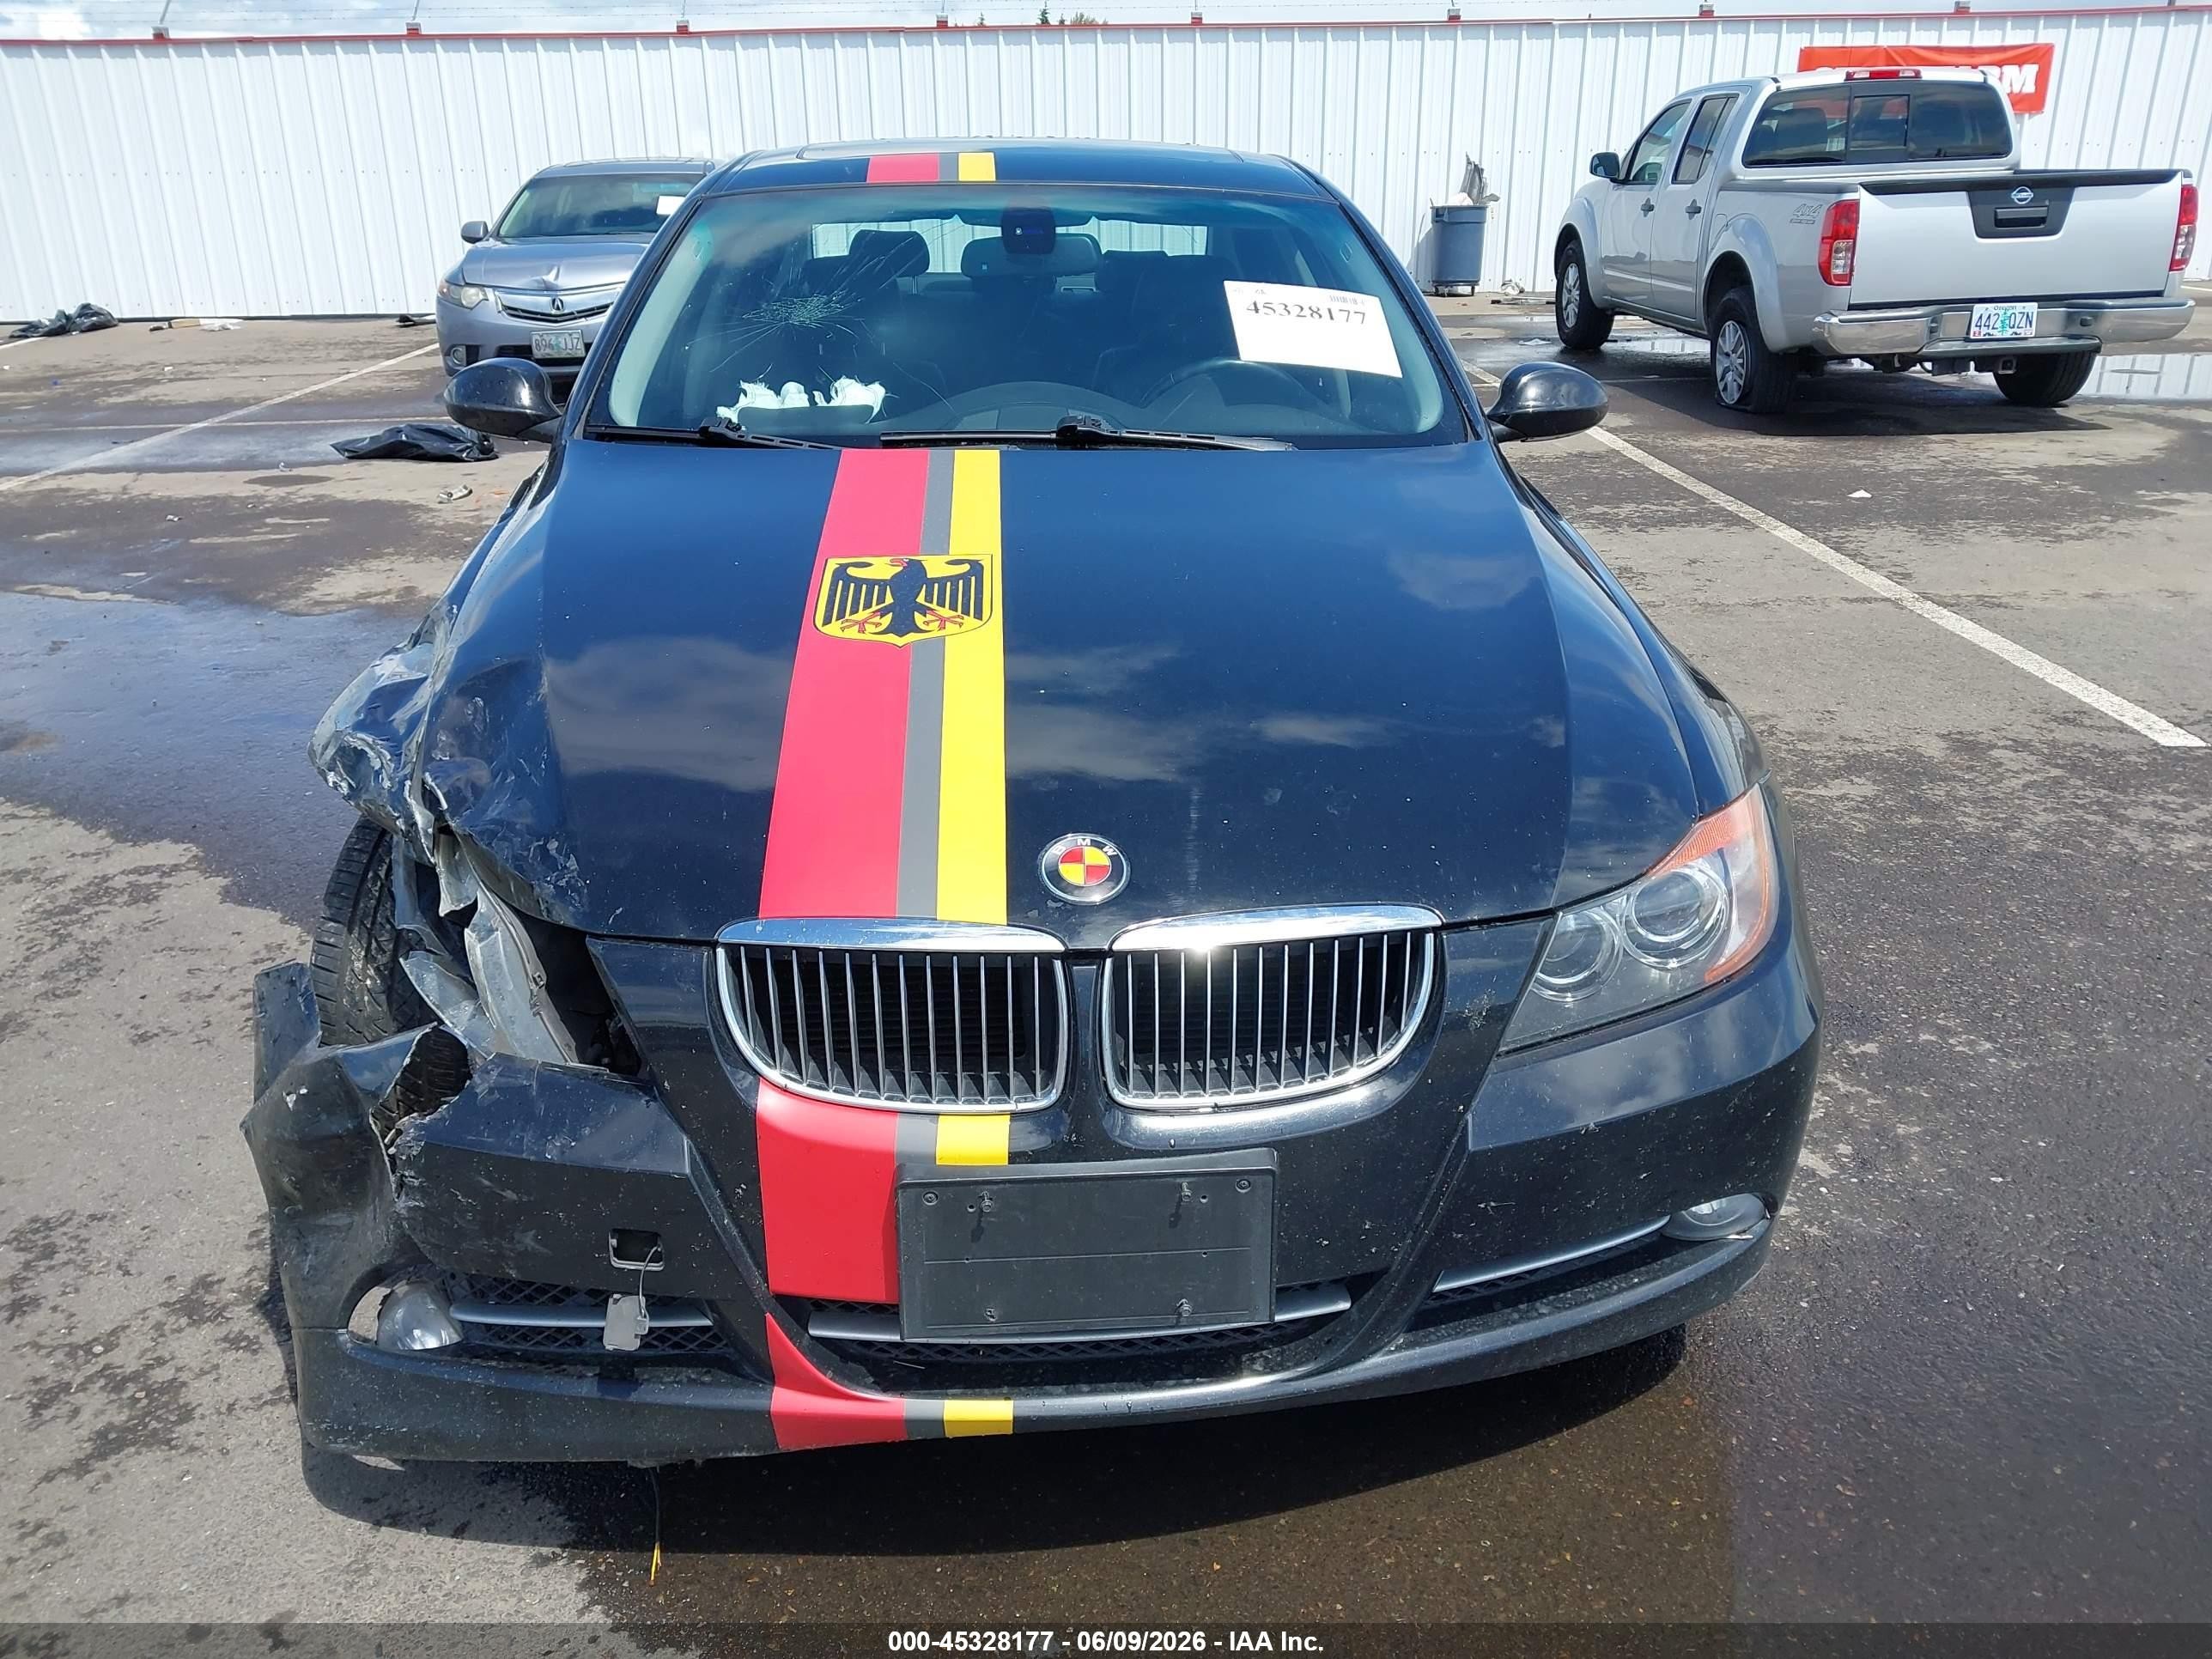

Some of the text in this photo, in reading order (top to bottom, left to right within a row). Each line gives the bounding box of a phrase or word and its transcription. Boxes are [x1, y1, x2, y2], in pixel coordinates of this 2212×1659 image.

[1245, 300, 1366, 325] 45328177
[1974, 311, 2034, 331] 442 QZN
[562, 335, 582, 350] JJZ
[1051, 837, 1118, 857] BMW
